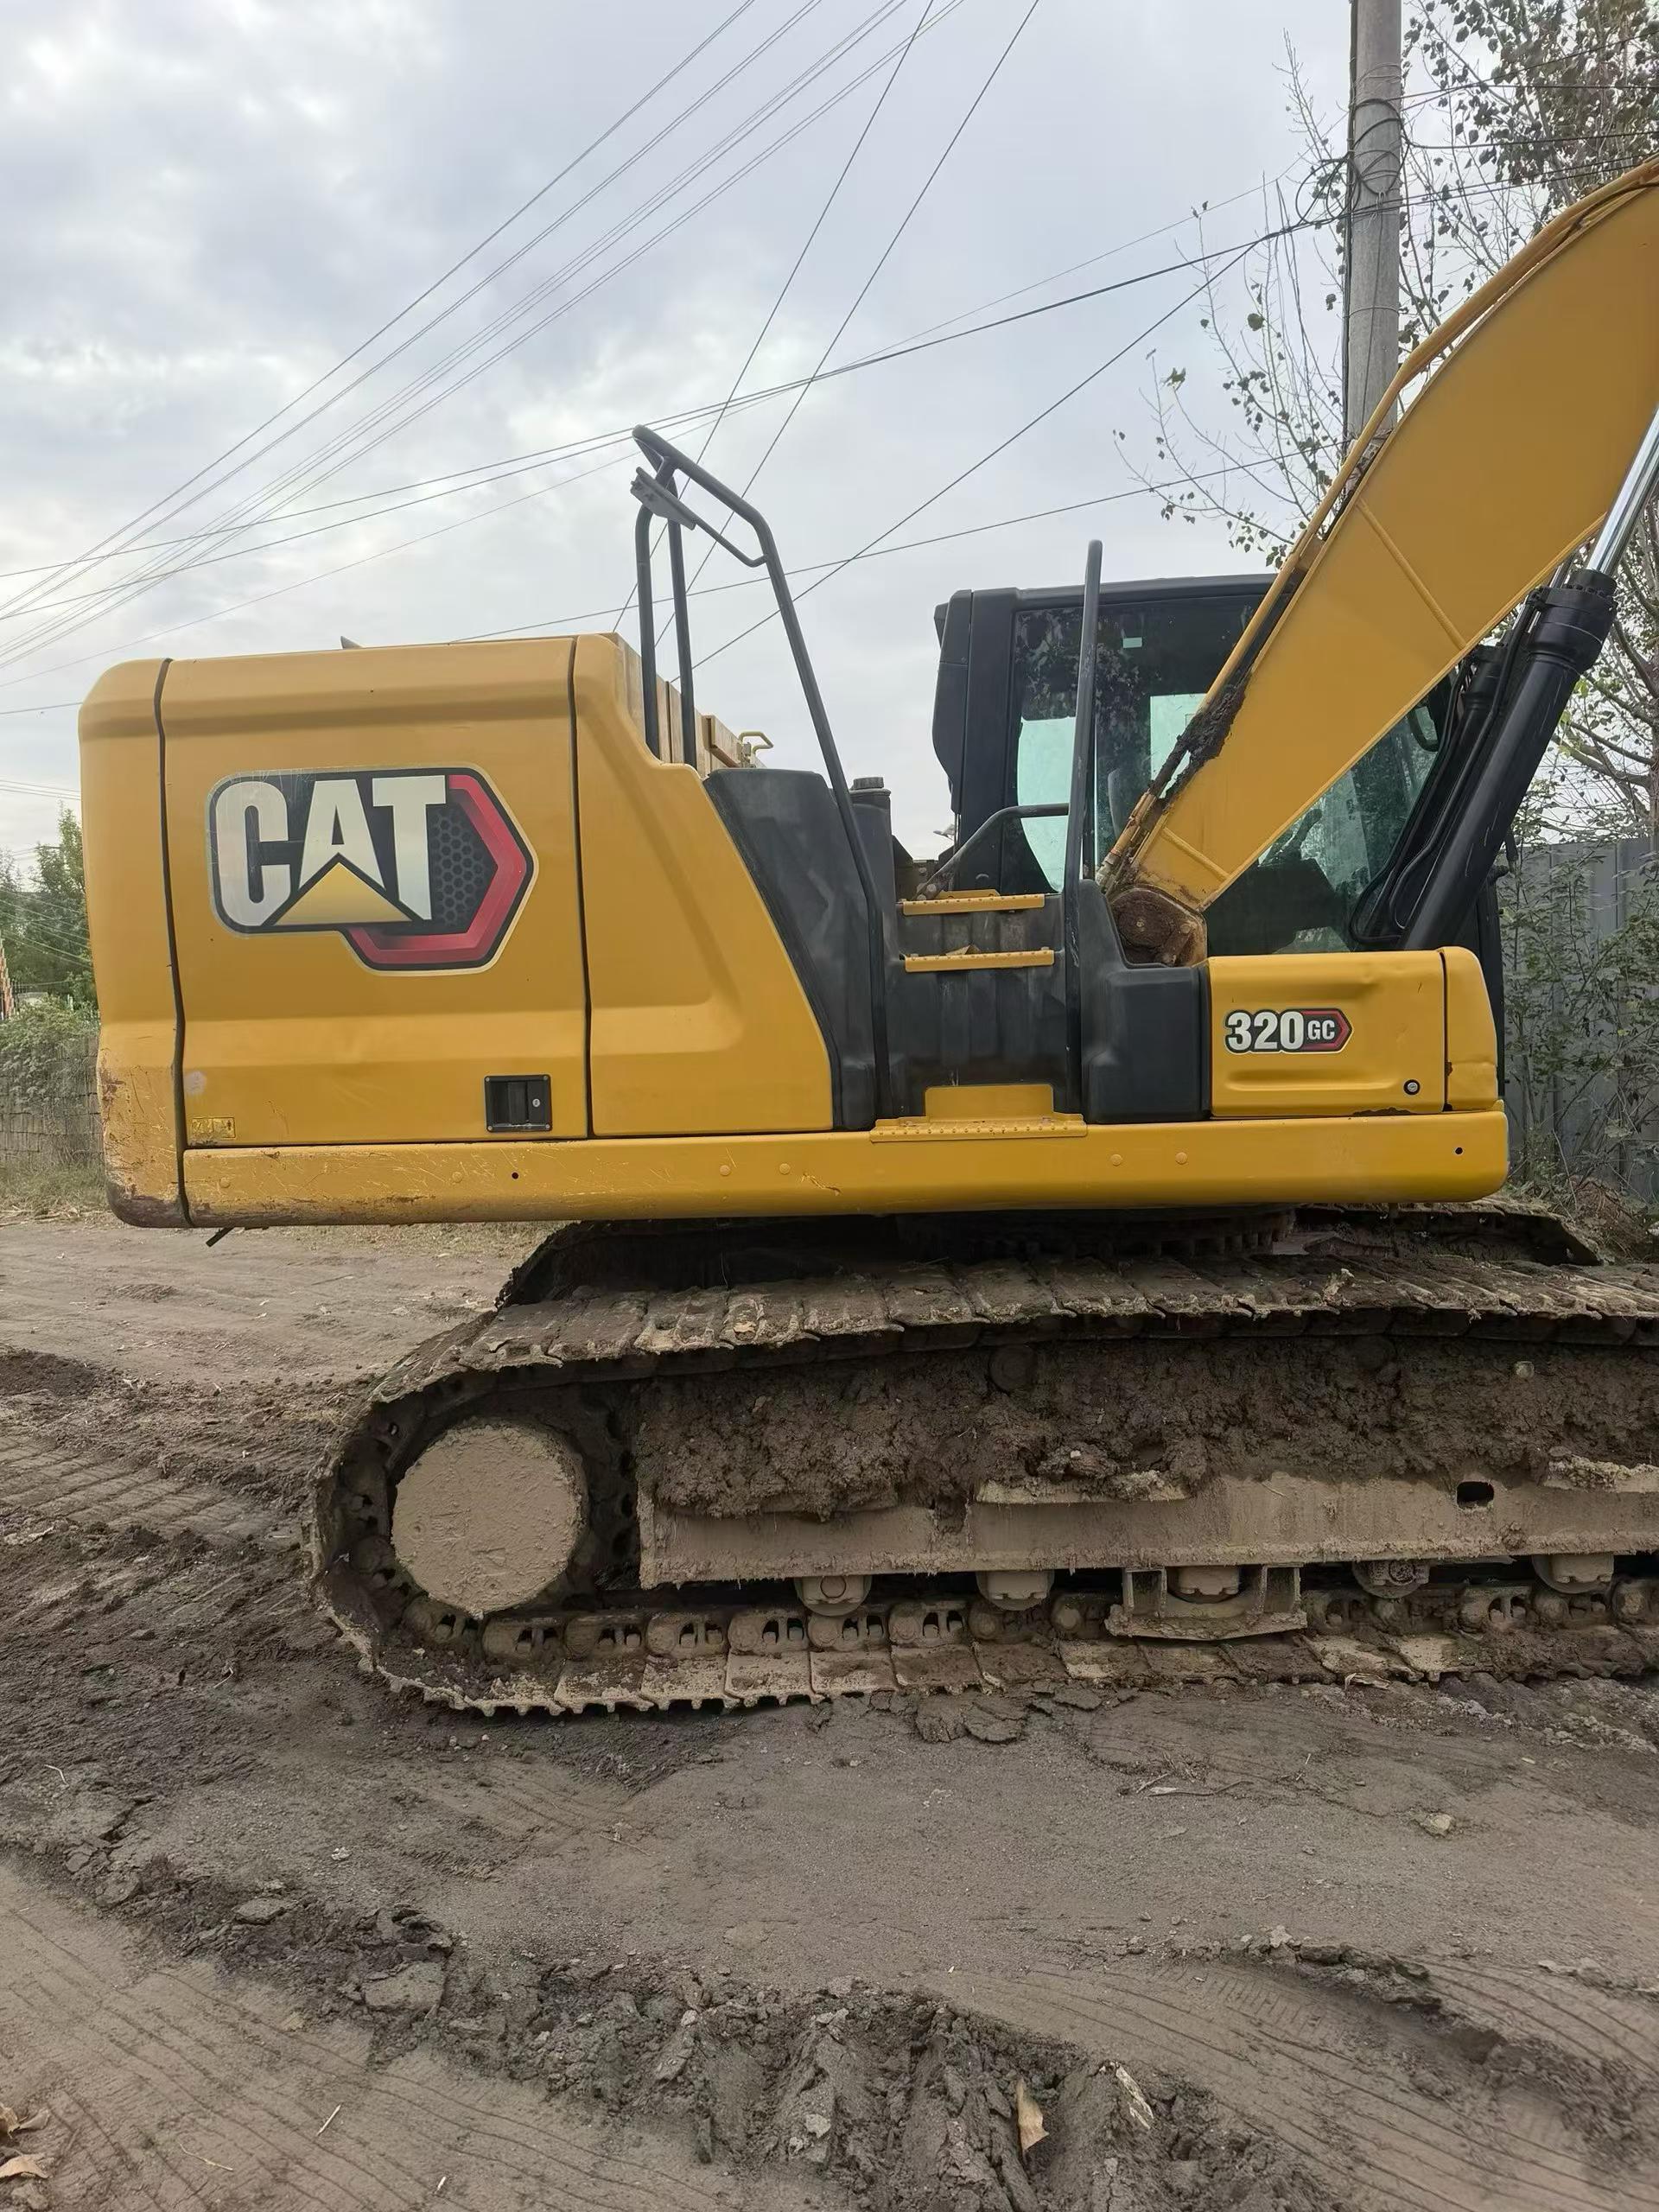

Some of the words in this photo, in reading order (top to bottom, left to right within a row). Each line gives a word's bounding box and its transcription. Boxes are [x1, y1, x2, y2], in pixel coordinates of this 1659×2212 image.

[215, 775, 447, 926] CAT
[1227, 1011, 1304, 1051] 320
[1307, 1020, 1335, 1040] GC
